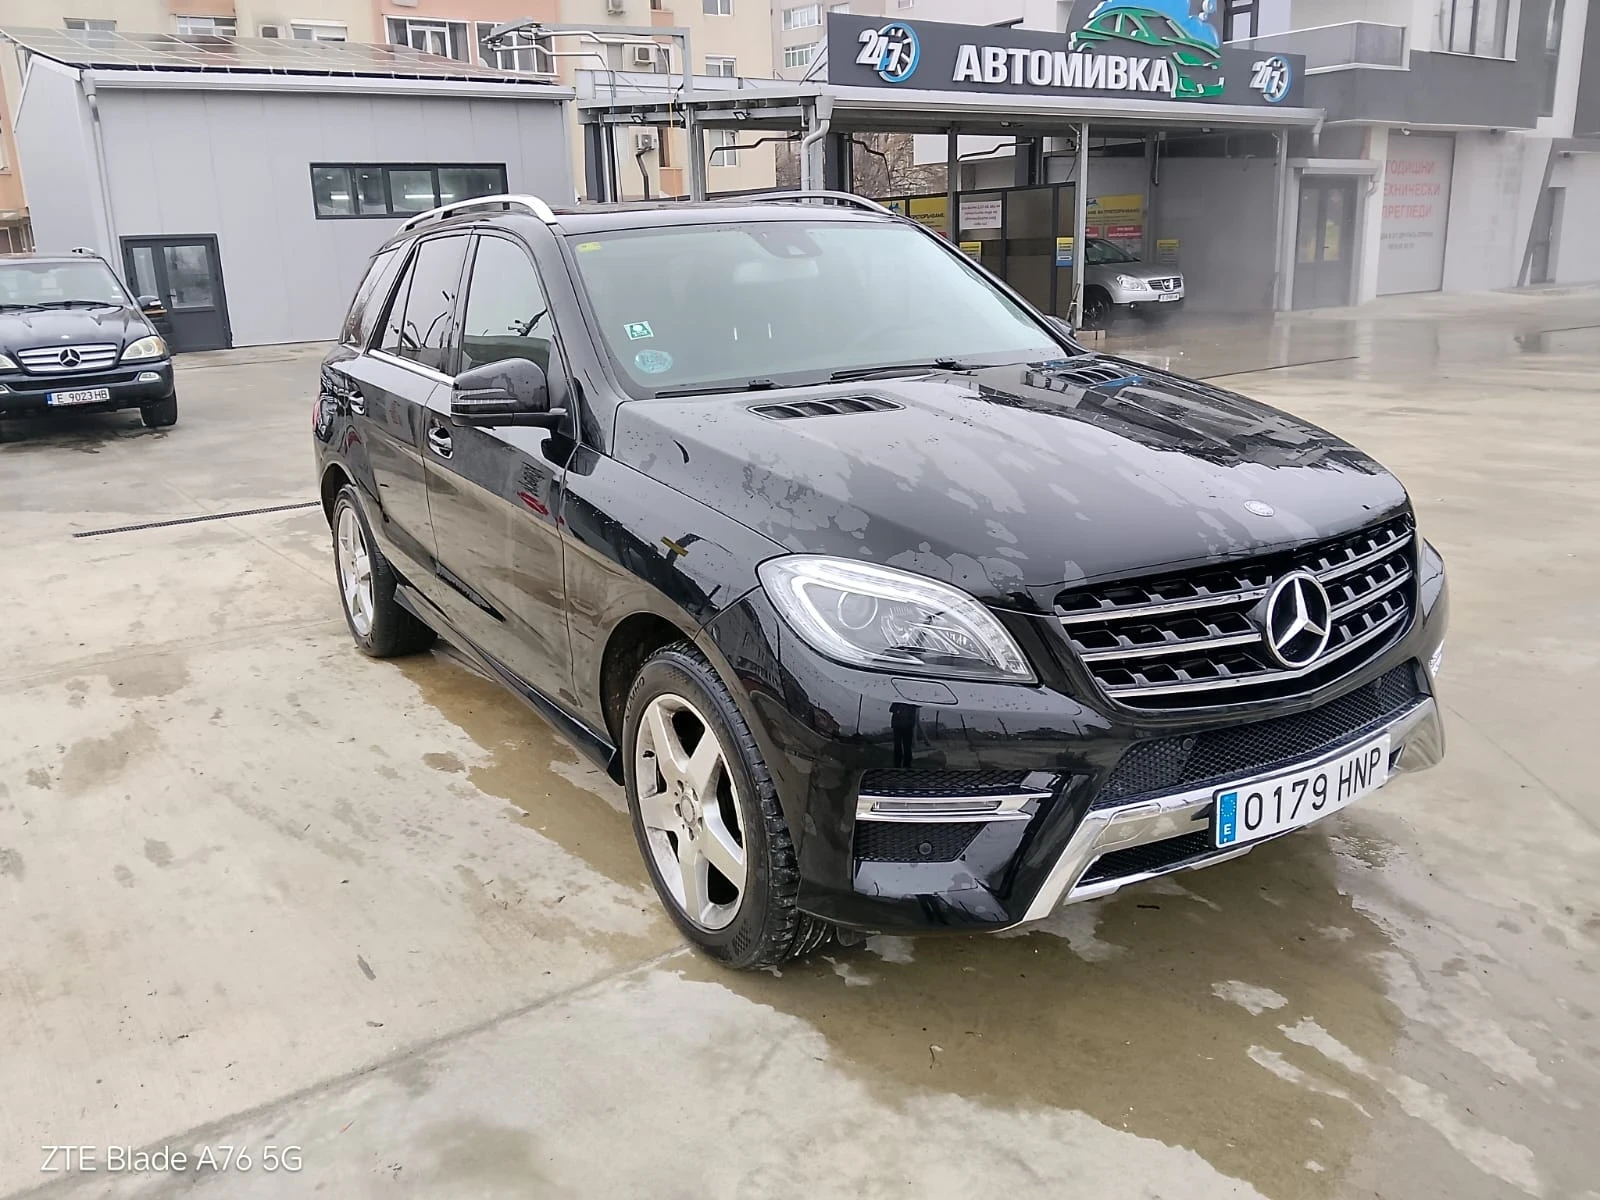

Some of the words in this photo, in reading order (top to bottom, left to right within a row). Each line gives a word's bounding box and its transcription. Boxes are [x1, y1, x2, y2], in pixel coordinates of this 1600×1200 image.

[952, 44, 1172, 93] АВТОМИВКА
[1383, 183, 1441, 197] ЕХНИЧЕСКИ
[69, 391, 93, 402] 9023
[1244, 773, 1328, 831] 0179
[1337, 747, 1381, 802] HNP
[1223, 823, 1232, 835] E
